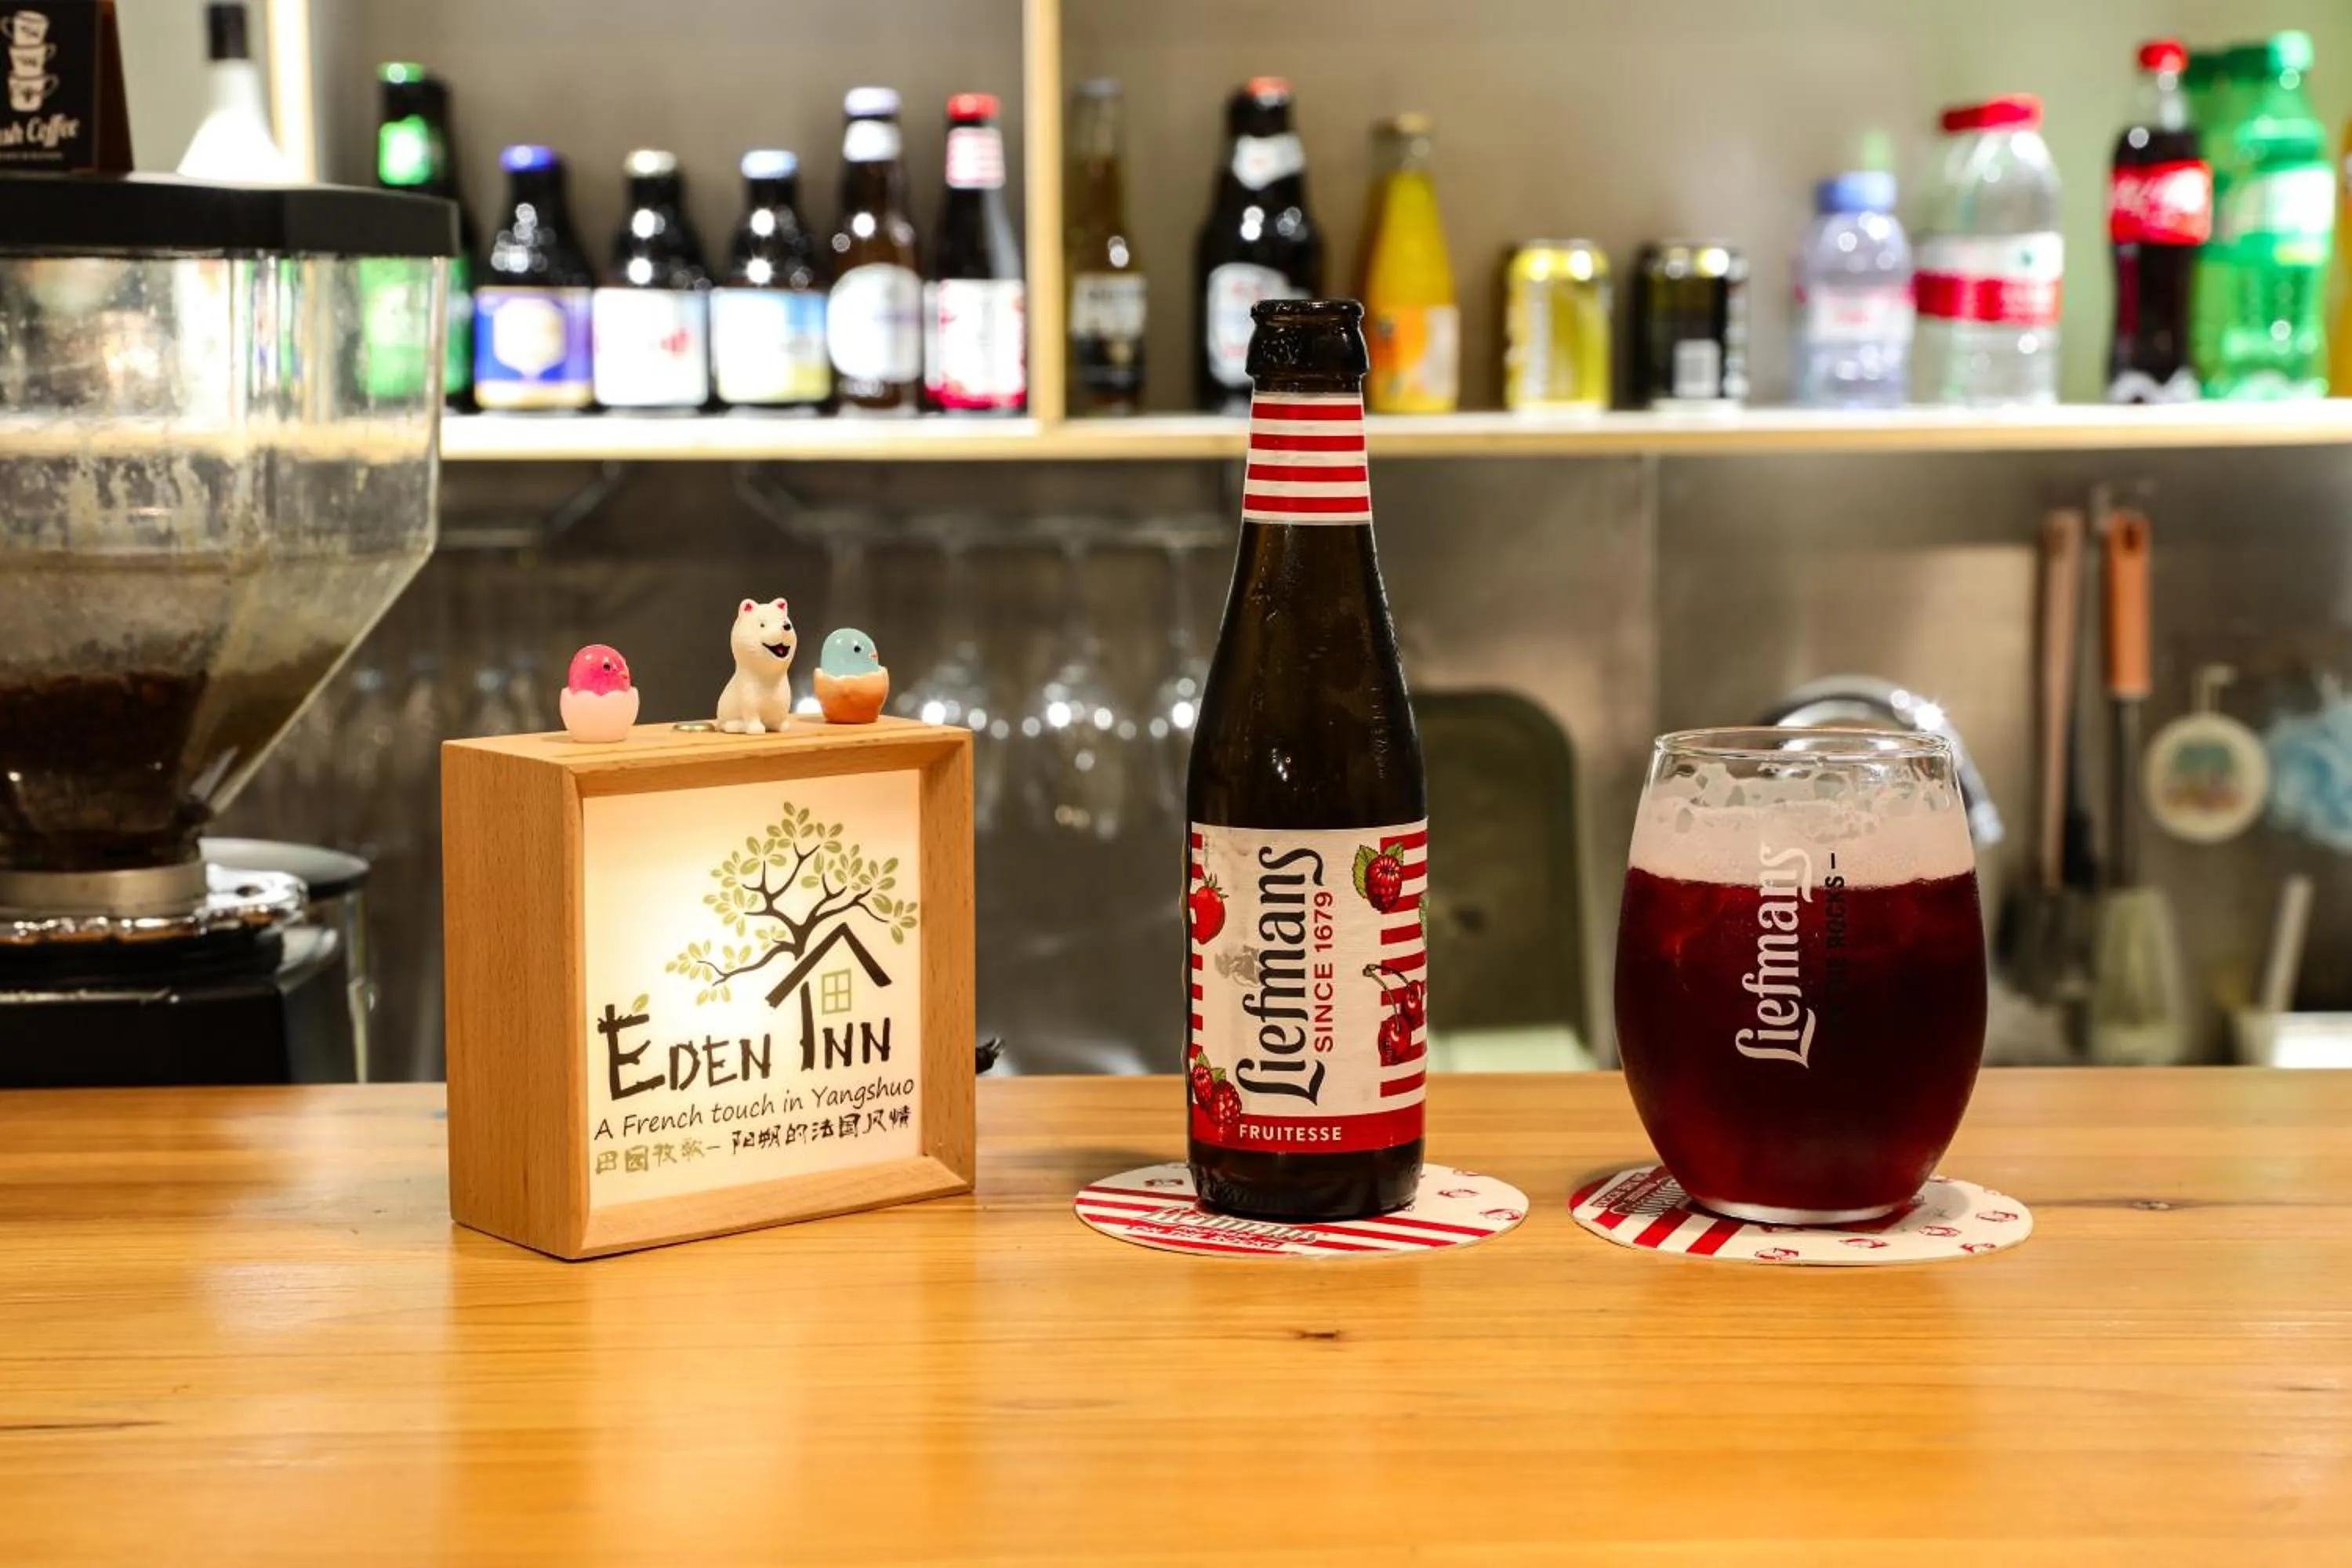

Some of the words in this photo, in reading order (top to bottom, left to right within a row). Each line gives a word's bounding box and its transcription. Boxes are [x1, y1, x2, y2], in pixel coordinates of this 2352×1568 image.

[1313, 891, 1334, 953] 1679
[1734, 842, 1817, 1069] Liefmans
[1235, 846, 1326, 1106] Liefmans
[1314, 962, 1334, 1053] SINCE
[597, 1004, 772, 1101] EDEN
[799, 981, 891, 1072] INN
[593, 1118, 614, 1141] A
[622, 1104, 703, 1138] French
[711, 1094, 775, 1123] touch
[782, 1088, 804, 1112] in
[811, 1076, 915, 1109] Yangshuo
[1239, 1123, 1343, 1142] FRUITESSE
